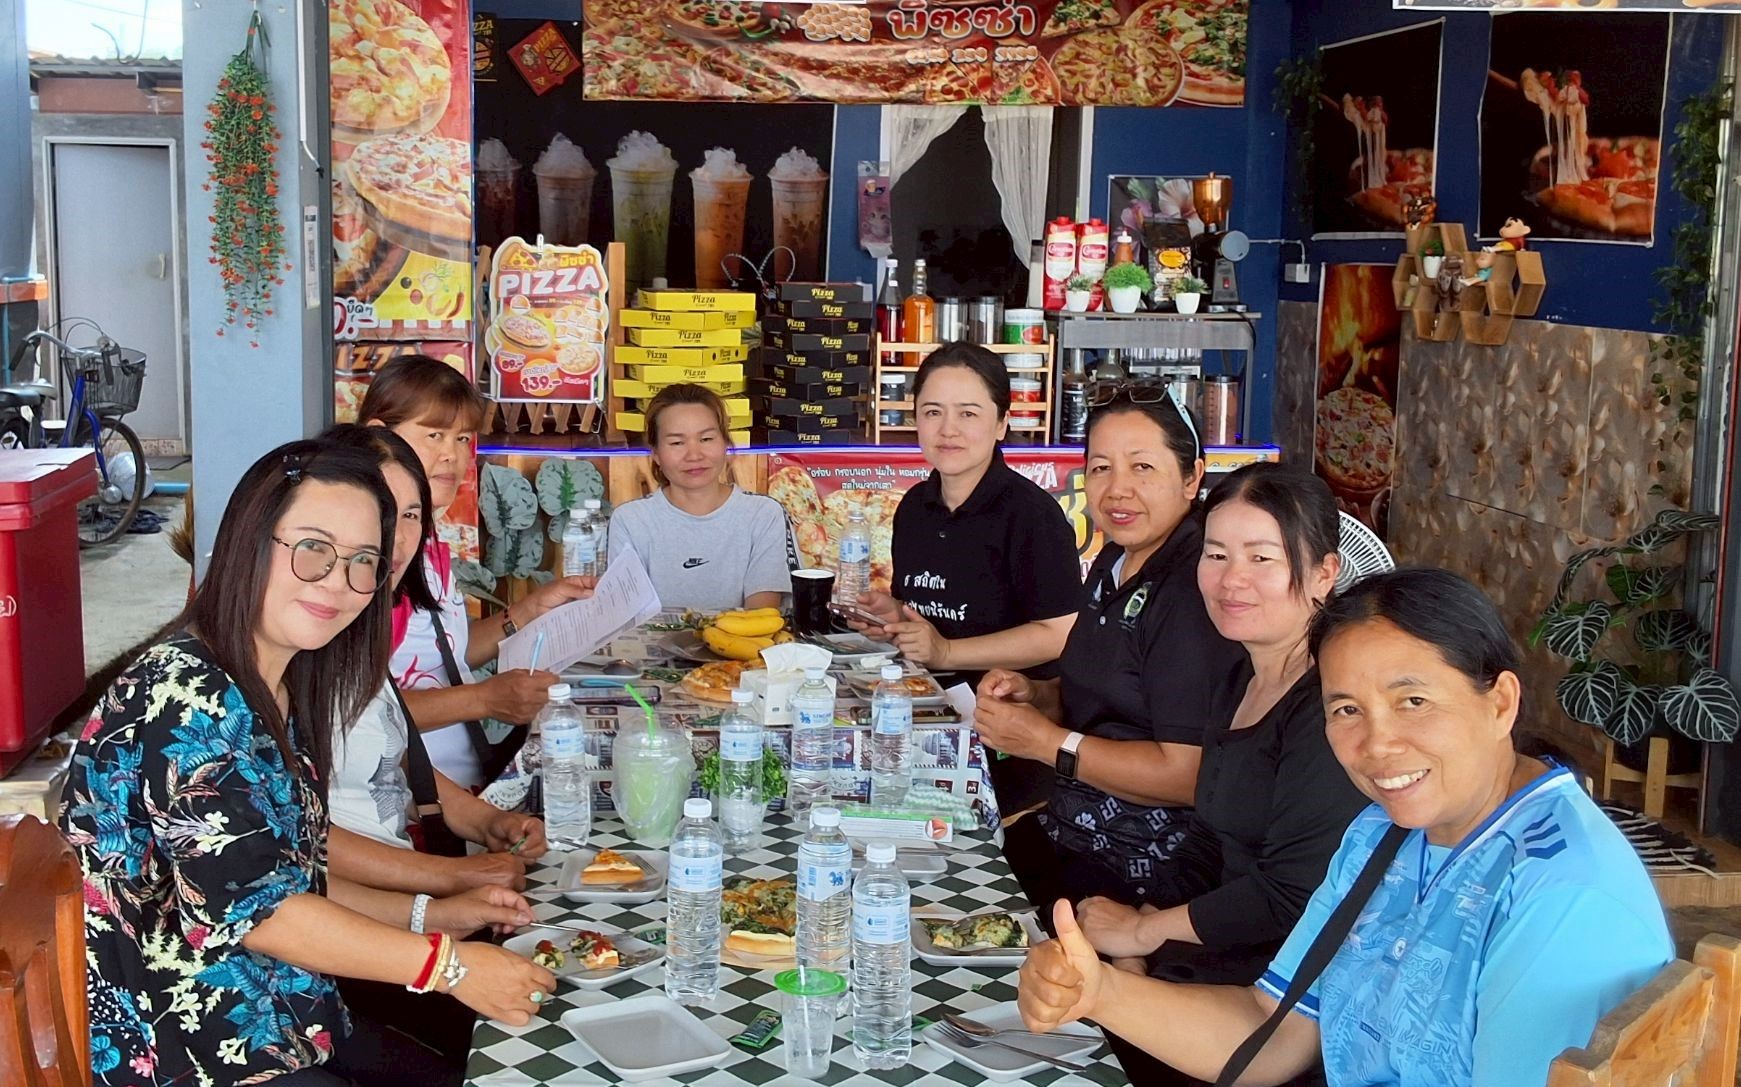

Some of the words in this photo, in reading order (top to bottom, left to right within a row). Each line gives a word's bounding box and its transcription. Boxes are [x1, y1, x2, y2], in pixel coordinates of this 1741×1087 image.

[499, 265, 600, 298] PIZZA
[811, 288, 834, 297] Pizza
[692, 294, 716, 304] Pizza
[822, 304, 843, 313] Pizza
[650, 312, 671, 322] Pizza
[786, 318, 806, 327] Pizza
[678, 330, 702, 340] Pizza
[821, 337, 843, 345] Pizza
[646, 350, 668, 359] Pizza
[786, 354, 806, 363] Pizza
[683, 369, 706, 377] Pizza
[822, 370, 843, 379] Pizza
[521, 375, 562, 391] 139.-
[768, 385, 787, 394] Pizza
[800, 403, 823, 412] Pizza
[820, 416, 838, 424] Pizza
[798, 433, 821, 441] Pizza
[835, 468, 872, 477] กรอบนอก
[876, 465, 896, 479] นุ่มใน
[786, 528, 797, 566] NIKE
[914, 570, 947, 590] สถิตใน
